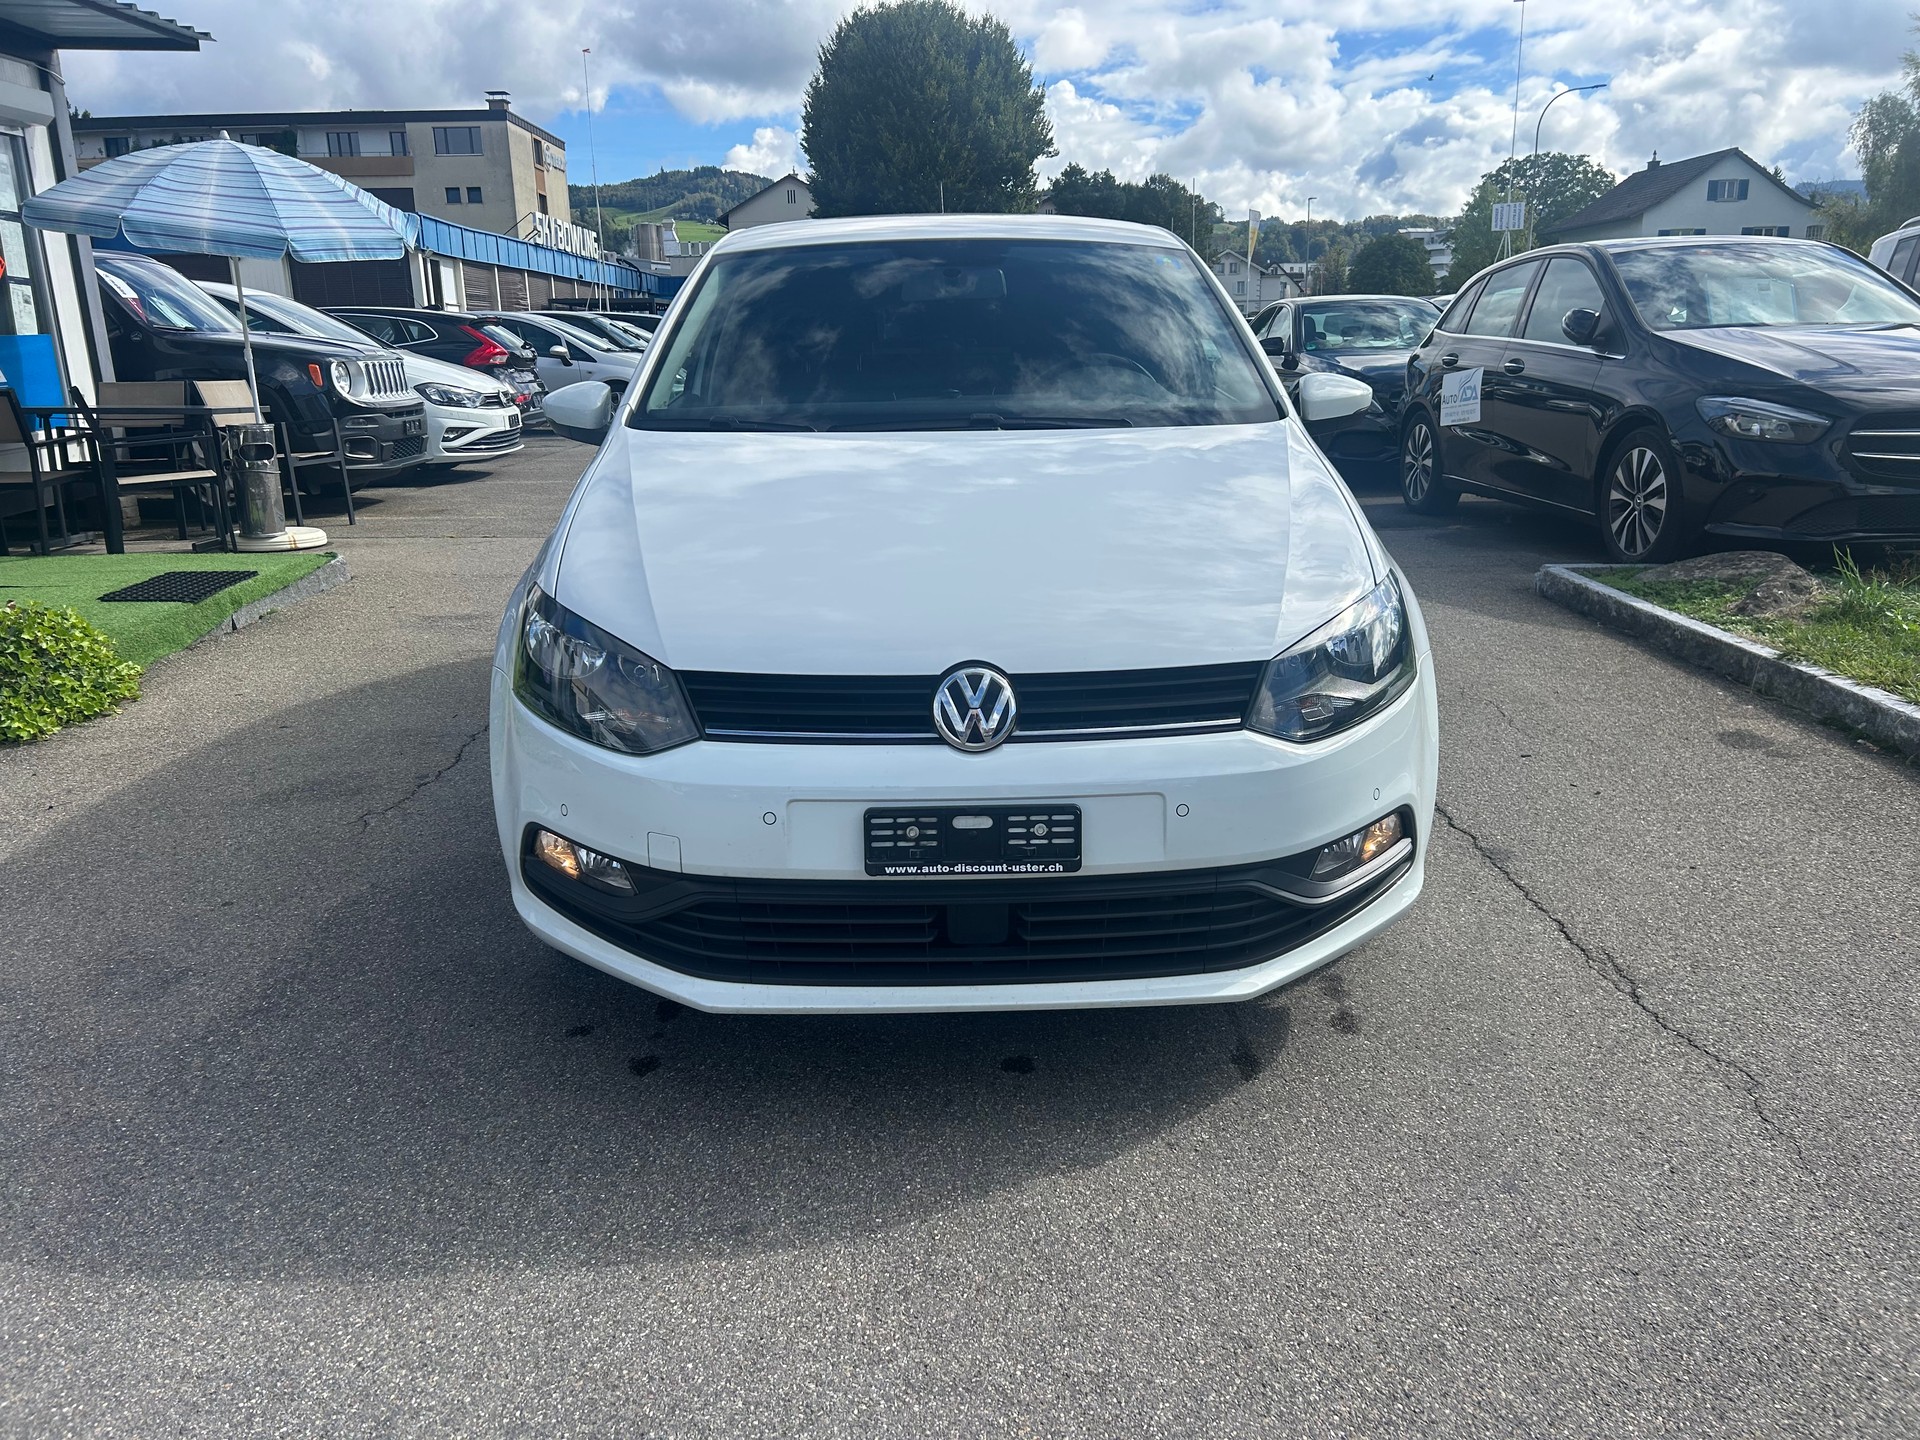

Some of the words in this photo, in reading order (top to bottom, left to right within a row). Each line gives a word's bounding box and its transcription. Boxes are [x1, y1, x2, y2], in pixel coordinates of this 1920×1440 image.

[556, 218, 599, 260] BOWLING
[933, 667, 1016, 751] VW
[885, 863, 1064, 874] www.auto-discount-uster.ch
